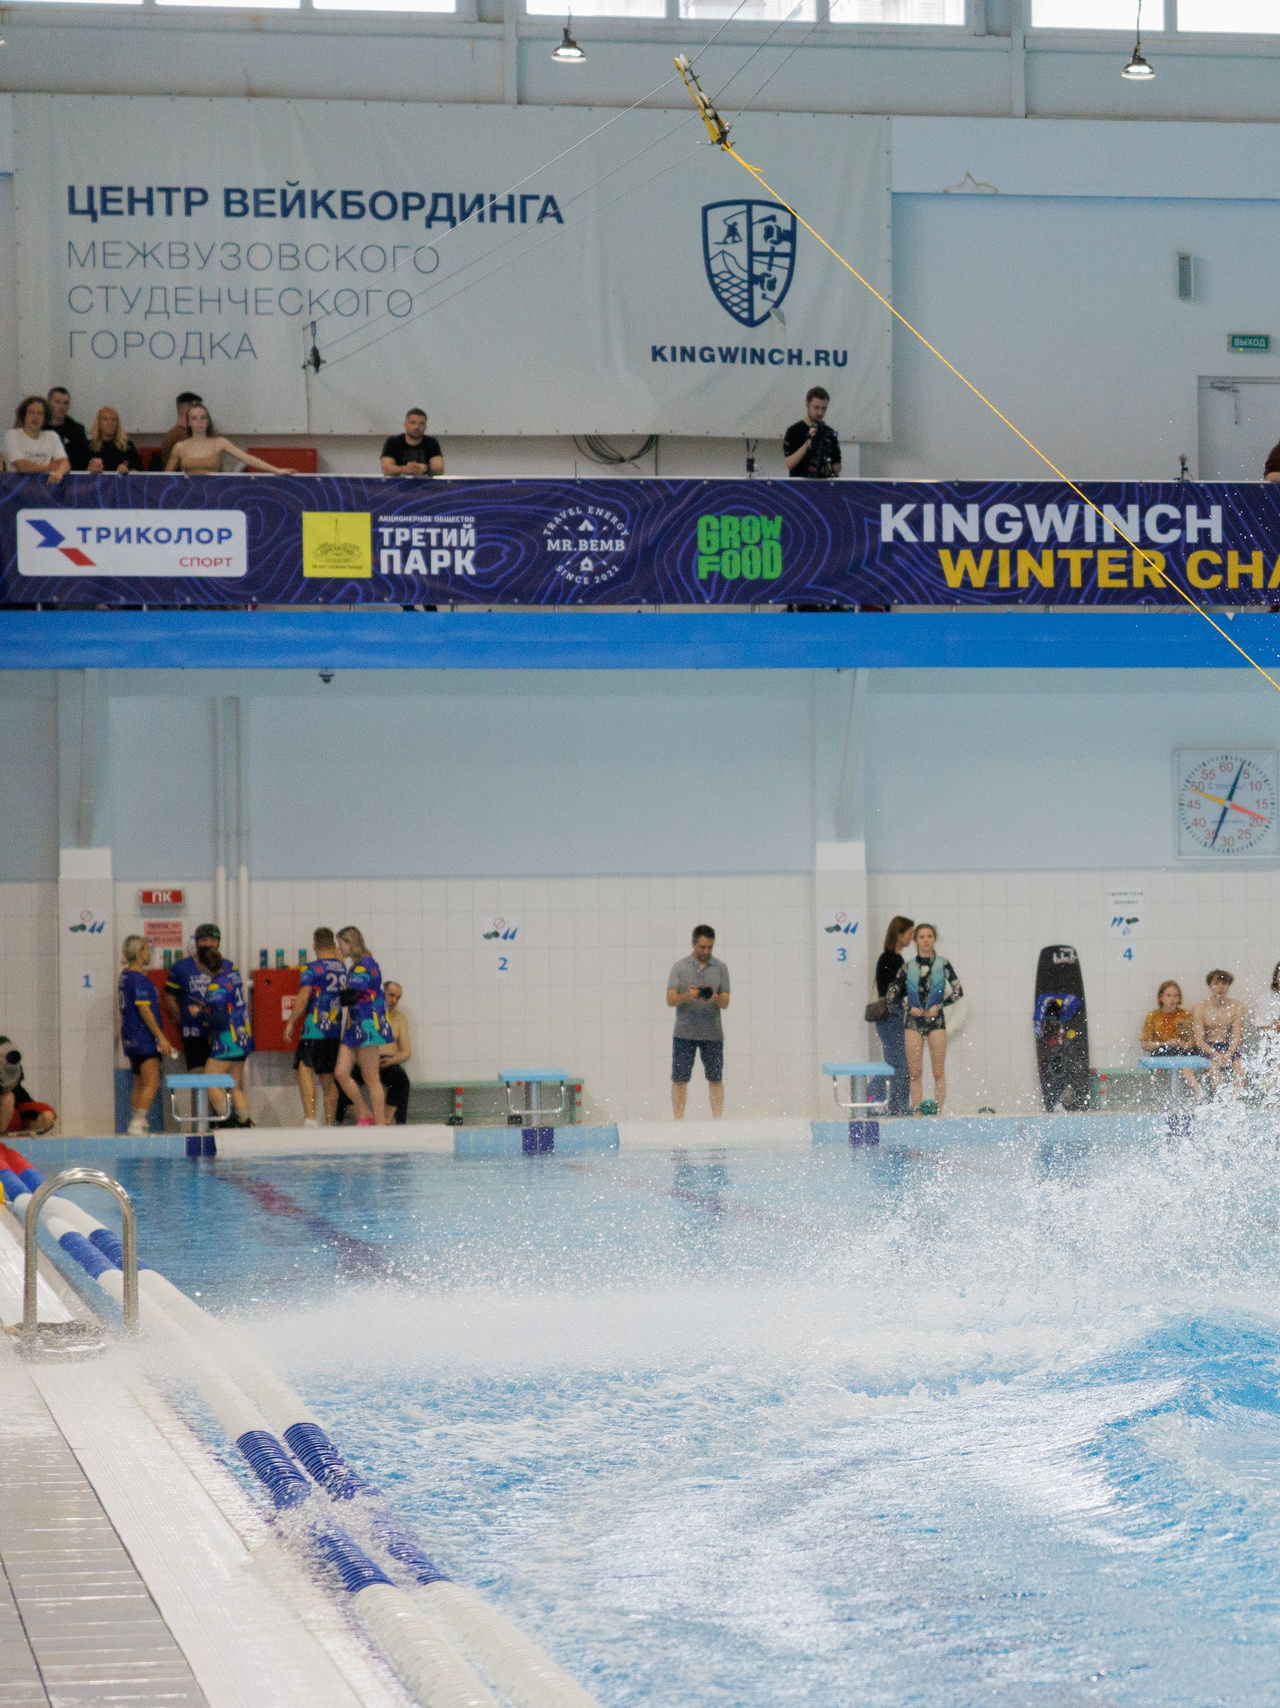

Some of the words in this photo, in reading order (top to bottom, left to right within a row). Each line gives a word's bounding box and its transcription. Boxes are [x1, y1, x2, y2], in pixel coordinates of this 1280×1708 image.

[67, 185, 209, 223] ЦЕНТР
[223, 180, 565, 229] ВЕЙКБОРДИНГА
[68, 240, 440, 274] МЕЖВУЗОВСКОГО
[68, 284, 413, 320] СТУДЕНЧЕСКОГО
[69, 330, 258, 365] ГОРОДКА
[1234, 337, 1266, 347] ВЫХОД
[651, 345, 848, 368] KINGWINCH.RU
[378, 515, 433, 523] АКЦИОНЕРНОЕ
[434, 515, 475, 523] ОБЩЕСТВО
[543, 506, 582, 536] TRAVEL
[588, 505, 629, 536] ENERGY
[880, 503, 1223, 544] KINGWINCH
[76, 526, 233, 545] ТРИКОЛОР
[378, 523, 476, 547] ТРЕТИЙ
[697, 514, 783, 555] GROW
[546, 539, 626, 552] MR.BEMB
[179, 556, 233, 568] СПОРТ
[380, 549, 476, 576] ПАРК
[697, 539, 783, 580] FOOD
[555, 564, 589, 585] SINCE
[594, 564, 620, 584] 2022
[938, 549, 1168, 589] WINTER
[1219, 762, 1234, 772] 60
[1201, 769, 1216, 780] 55
[1243, 769, 1251, 780] 5
[1249, 781, 1263, 791] 10
[1186, 799, 1201, 809] 45
[1255, 799, 1270, 809] 15
[1192, 817, 1206, 827] 40
[1237, 829, 1252, 840] 25
[1220, 836, 1234, 847] 30
[151, 892, 171, 903] ПК
[837, 948, 847, 961] 3
[1123, 947, 1133, 960] 4
[498, 957, 508, 970] 2
[83, 974, 92, 988] 1
